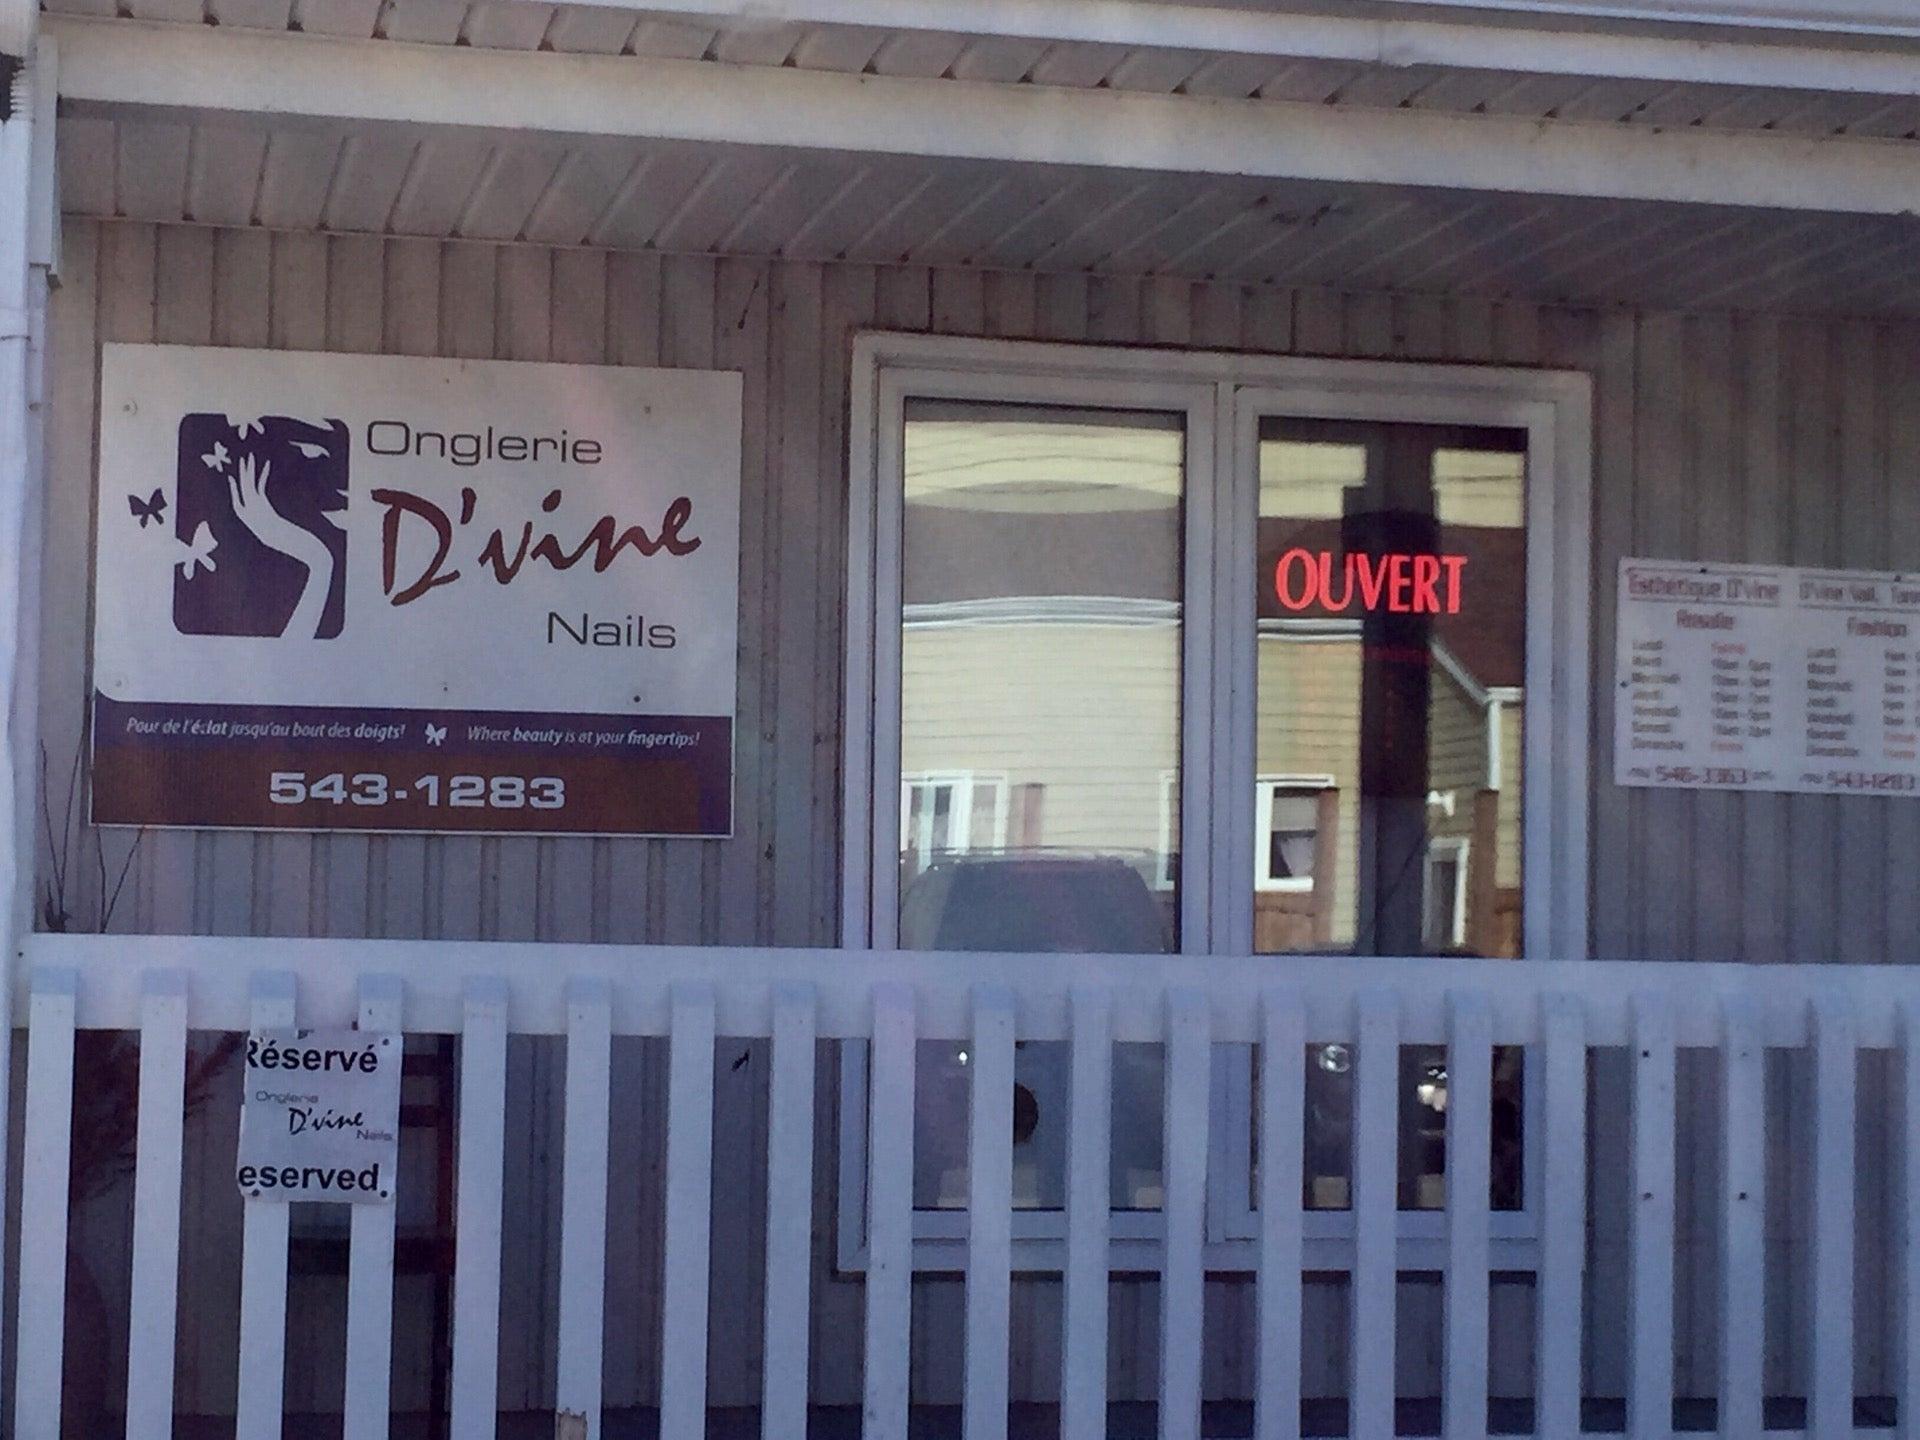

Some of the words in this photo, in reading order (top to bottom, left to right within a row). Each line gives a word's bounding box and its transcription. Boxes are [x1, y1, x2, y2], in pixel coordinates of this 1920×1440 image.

[367, 420, 602, 467] Onglerie
[370, 486, 702, 606] D'vine
[1275, 547, 1468, 614] OUVERT
[547, 611, 676, 649] Nails
[126, 716, 160, 735] Pour
[162, 718, 181, 735] de
[292, 721, 326, 738] bout
[327, 722, 351, 738] des
[354, 722, 406, 743] doigts!
[466, 725, 511, 742] Where
[512, 726, 562, 746] beauty
[564, 727, 577, 743] is
[577, 729, 593, 743] at
[594, 729, 626, 748] your
[627, 729, 701, 749] fingertips!
[268, 771, 566, 810] 543-1283
[288, 1107, 364, 1136] D'vine
